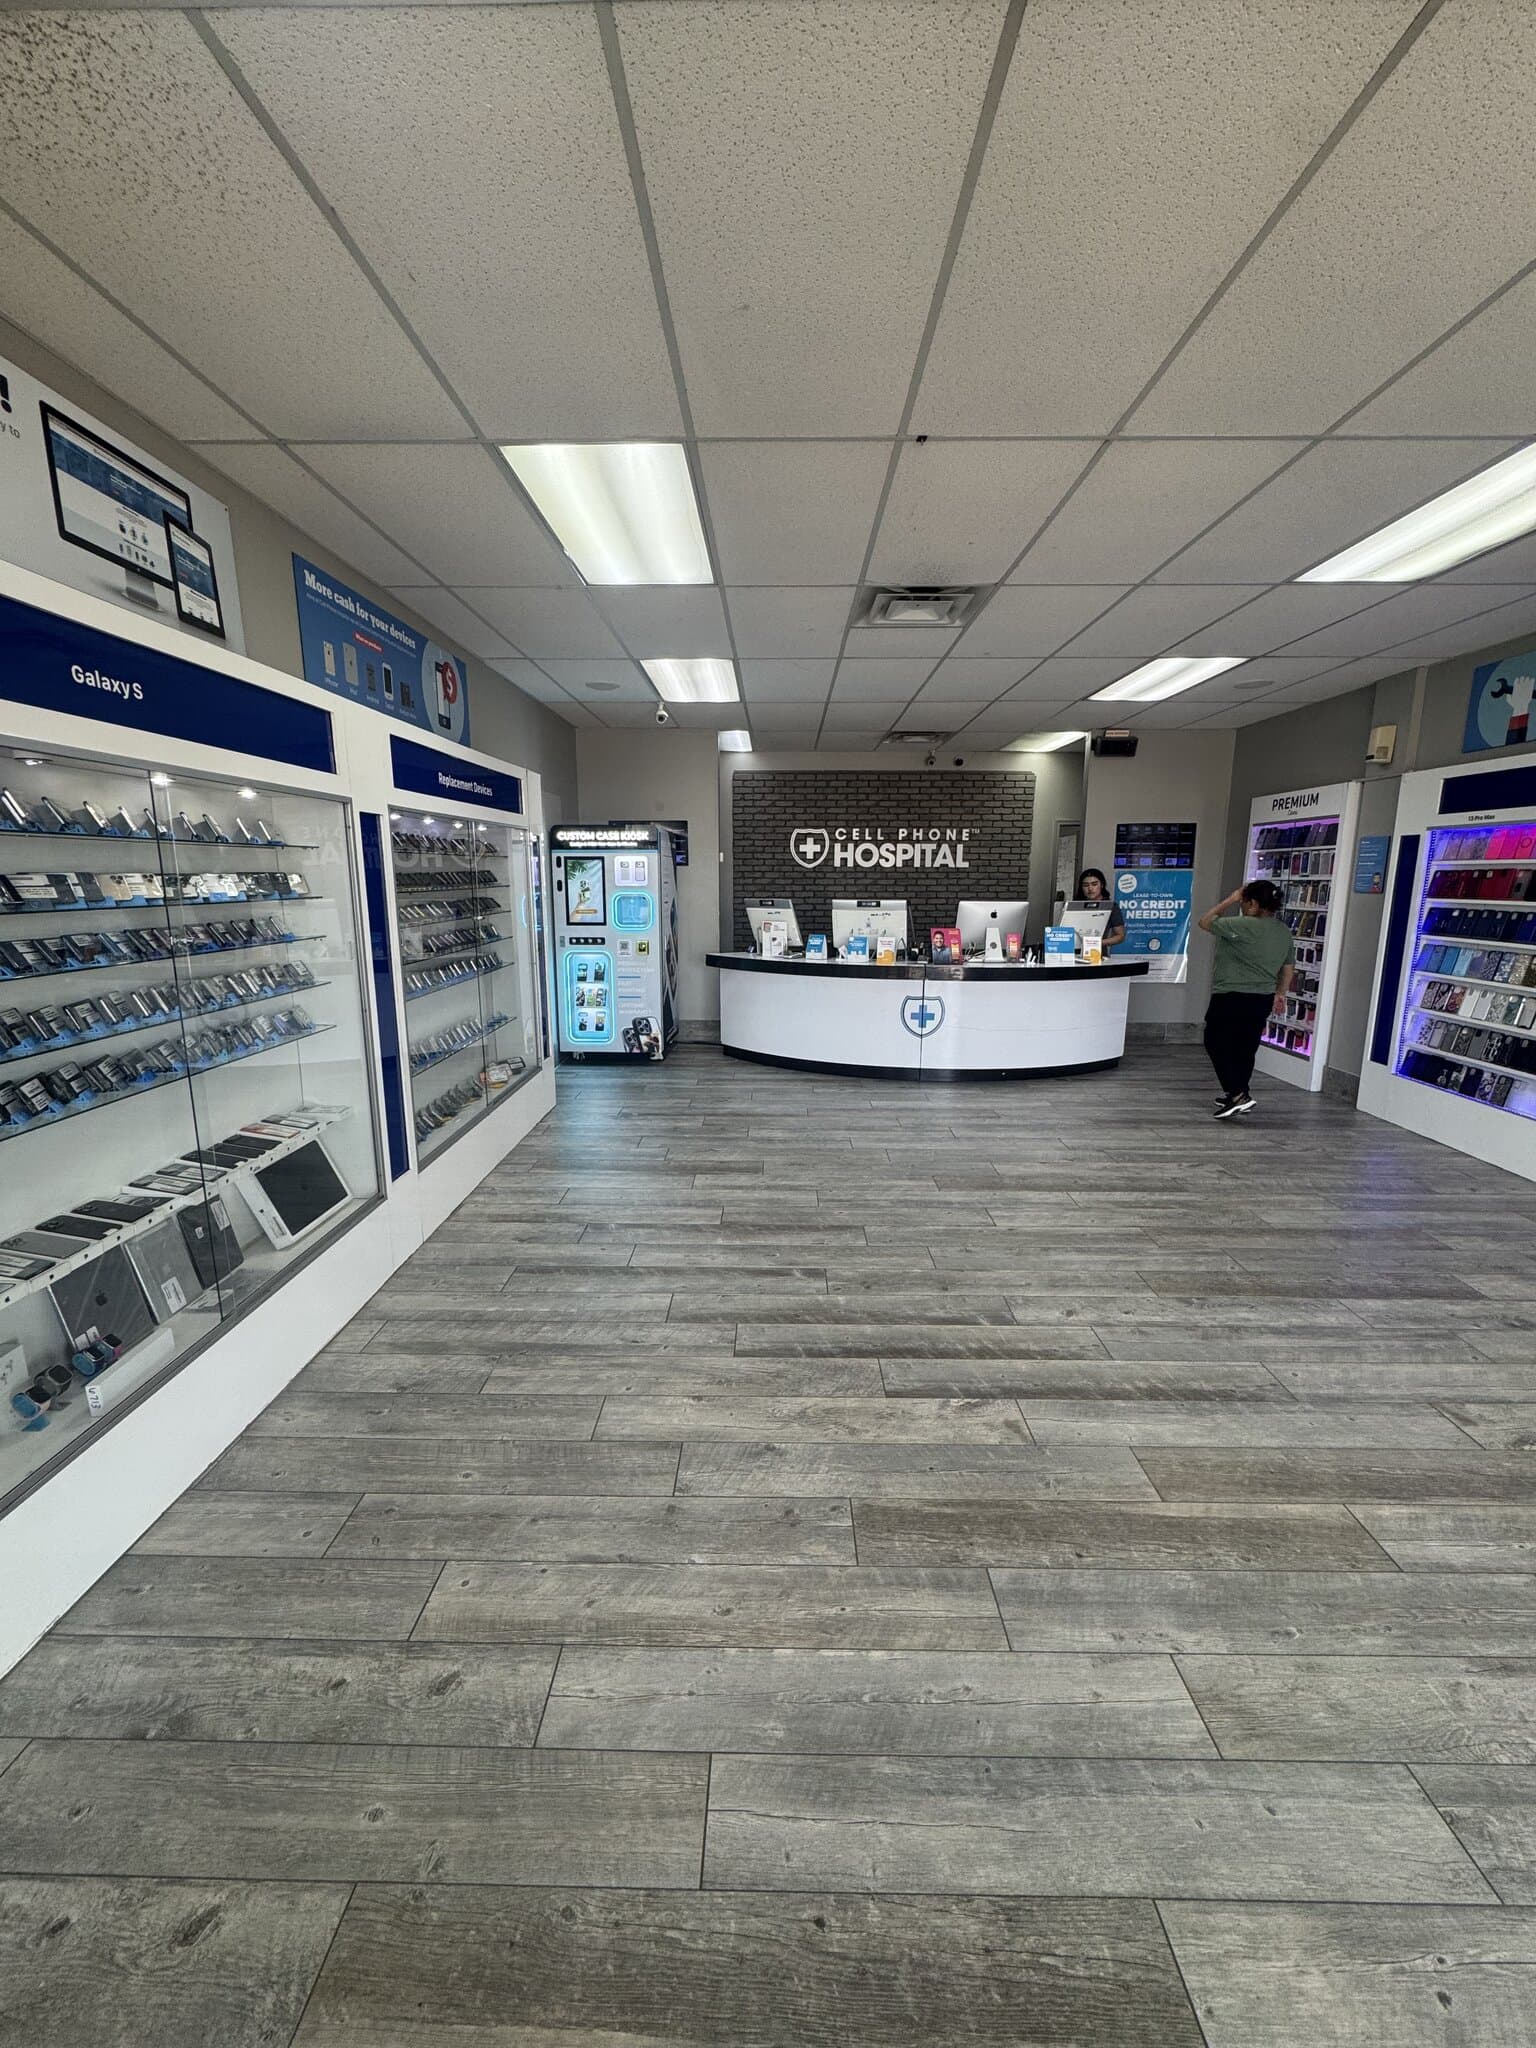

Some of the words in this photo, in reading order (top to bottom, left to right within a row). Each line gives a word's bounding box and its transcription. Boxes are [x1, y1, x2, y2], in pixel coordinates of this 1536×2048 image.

[304, 569, 333, 599] More
[334, 593, 355, 613] cash
[356, 602, 369, 621] for
[370, 614, 389, 632] your
[390, 624, 416, 649] devices
[71, 664, 130, 700] Galaxy
[132, 682, 143, 700] S
[438, 771, 473, 792] Replacement
[473, 782, 493, 796] Devices
[1272, 792, 1319, 811] PREMIUM
[556, 830, 595, 841] CUSTOM
[596, 831, 620, 841] CASE
[620, 831, 649, 841] KIOSK
[835, 828, 884, 840] CELL
[899, 828, 970, 840] PHONE
[834, 843, 969, 868] HOSPITAL
[1120, 900, 1138, 909] NO
[1141, 900, 1187, 909] CREDIT
[1126, 911, 1176, 919] NEEDED
